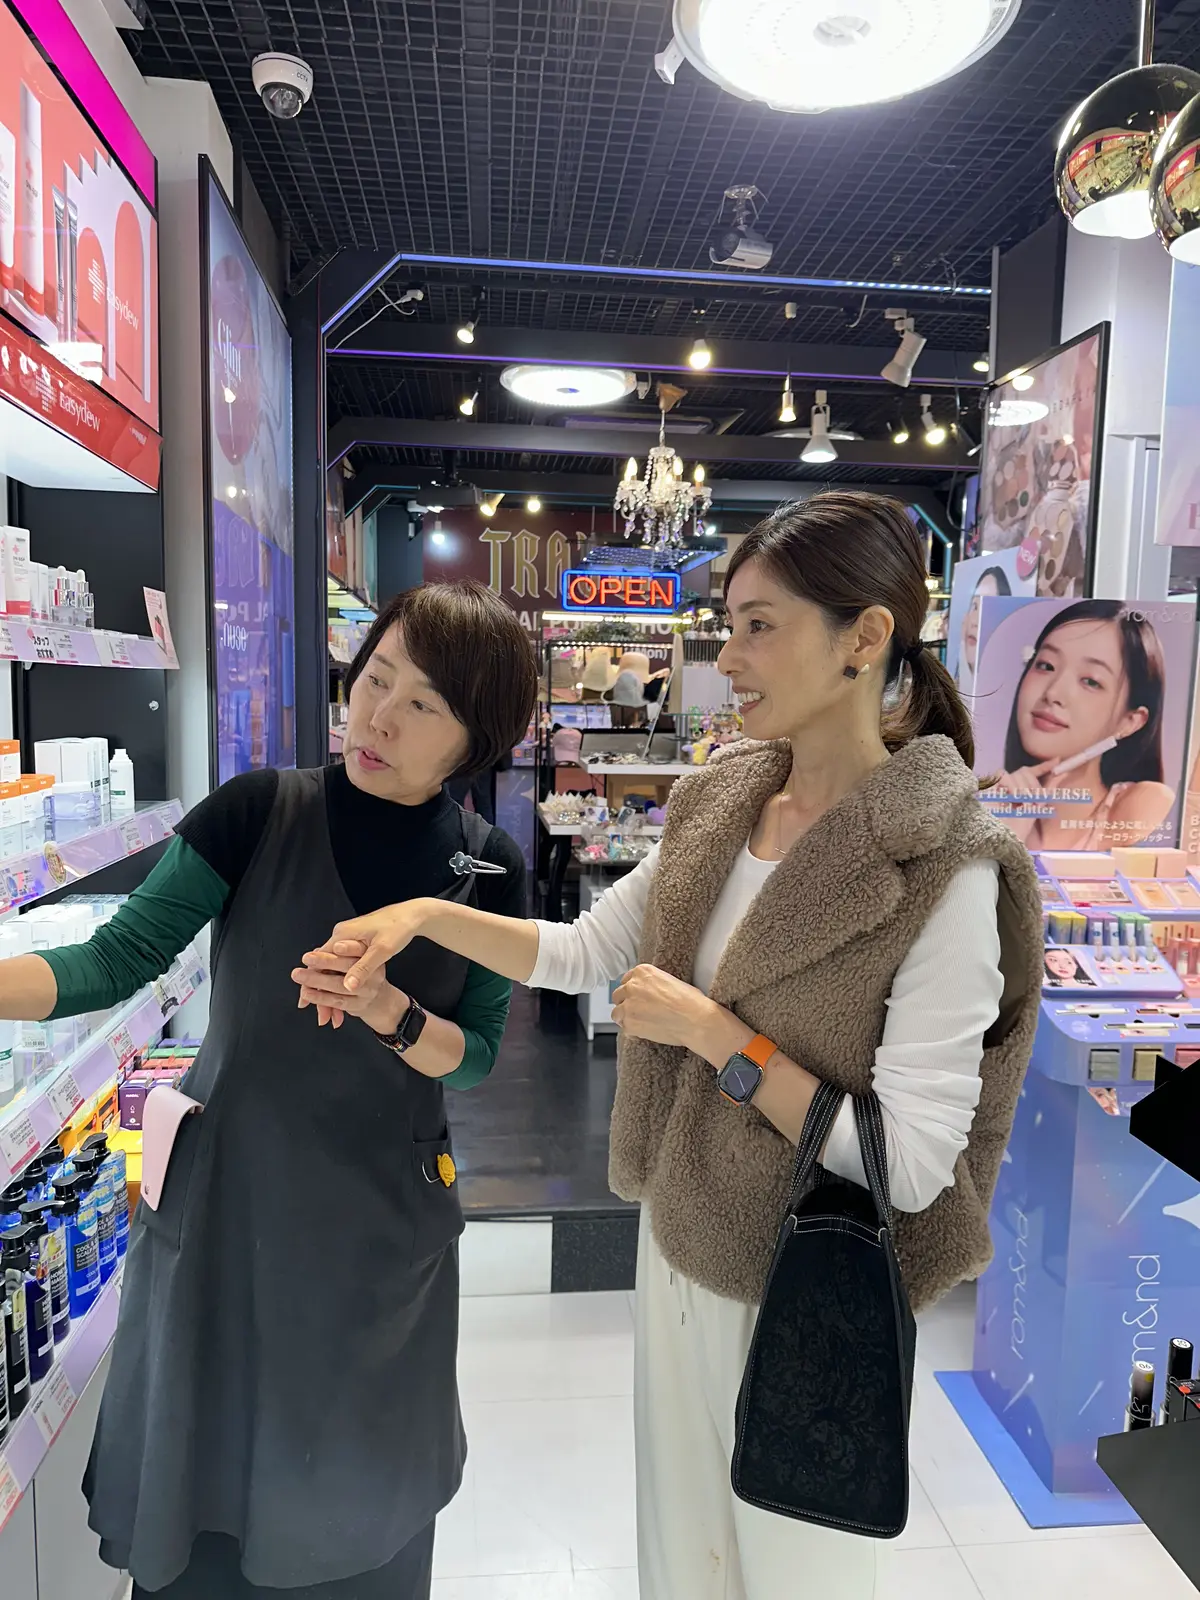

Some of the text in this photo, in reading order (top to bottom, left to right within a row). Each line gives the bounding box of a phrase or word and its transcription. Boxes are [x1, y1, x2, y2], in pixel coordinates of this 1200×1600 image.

[217, 318, 242, 383] Glint
[59, 391, 101, 432] Easydew
[568, 576, 674, 607] OPEN
[1013, 787, 1092, 801] UNIVERSE
[1016, 802, 1054, 816] glitter
